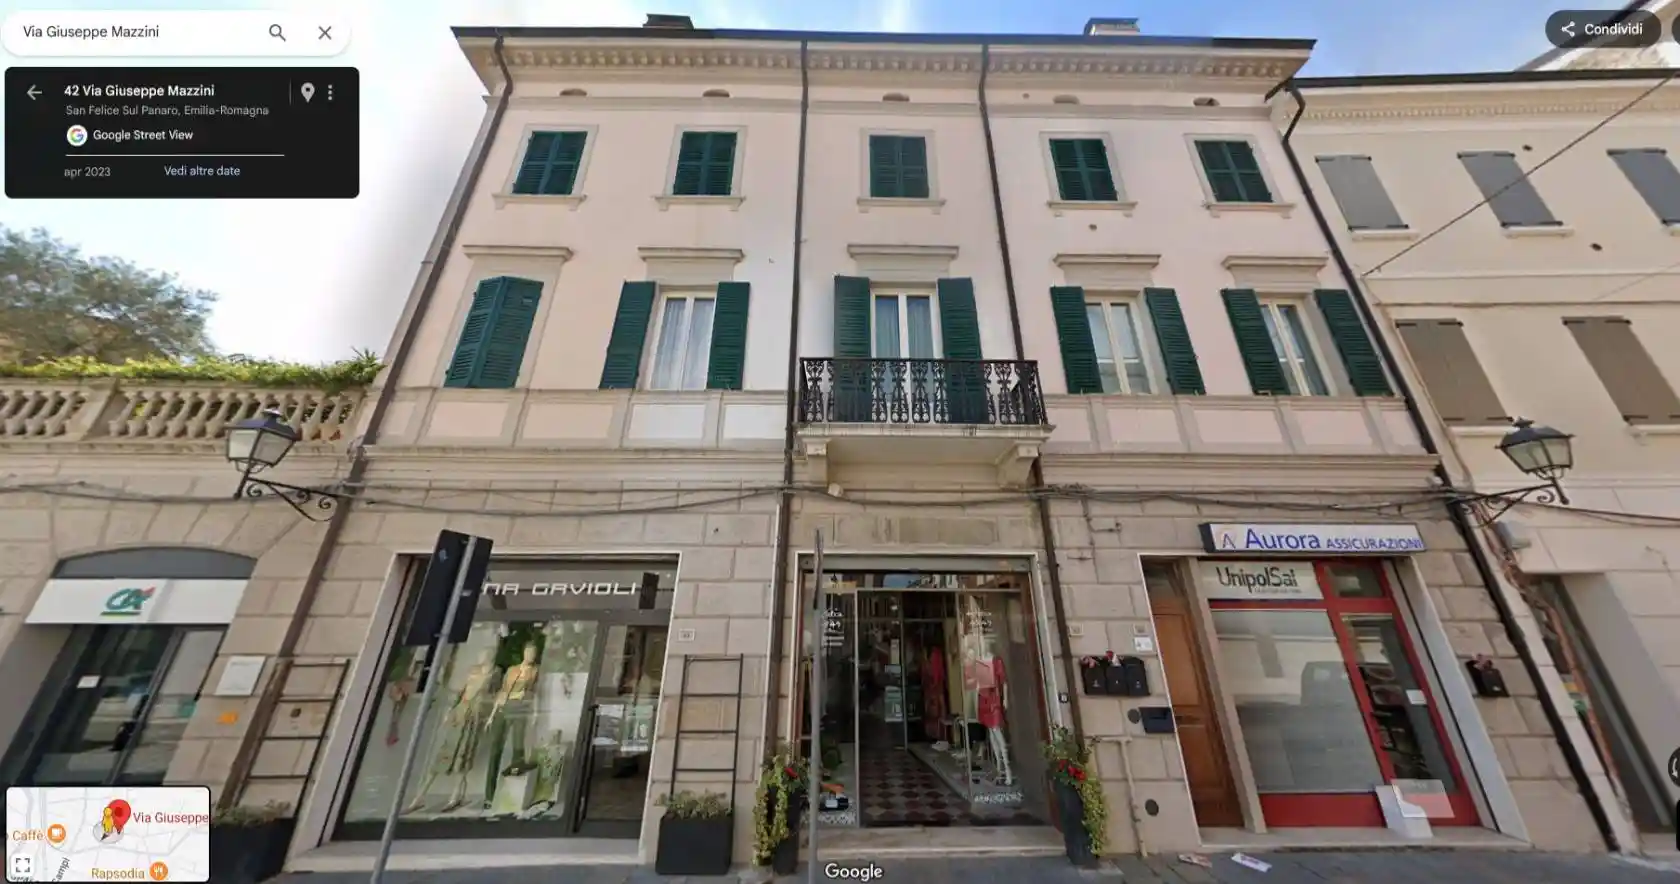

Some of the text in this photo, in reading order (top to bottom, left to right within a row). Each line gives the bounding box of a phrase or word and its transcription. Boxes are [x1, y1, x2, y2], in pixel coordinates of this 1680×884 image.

[1245, 528, 1423, 550] Aurora ASSICURAZIONI
[532, 582, 637, 596] GAVIOLI
[1216, 565, 1298, 595] UnipolSai
